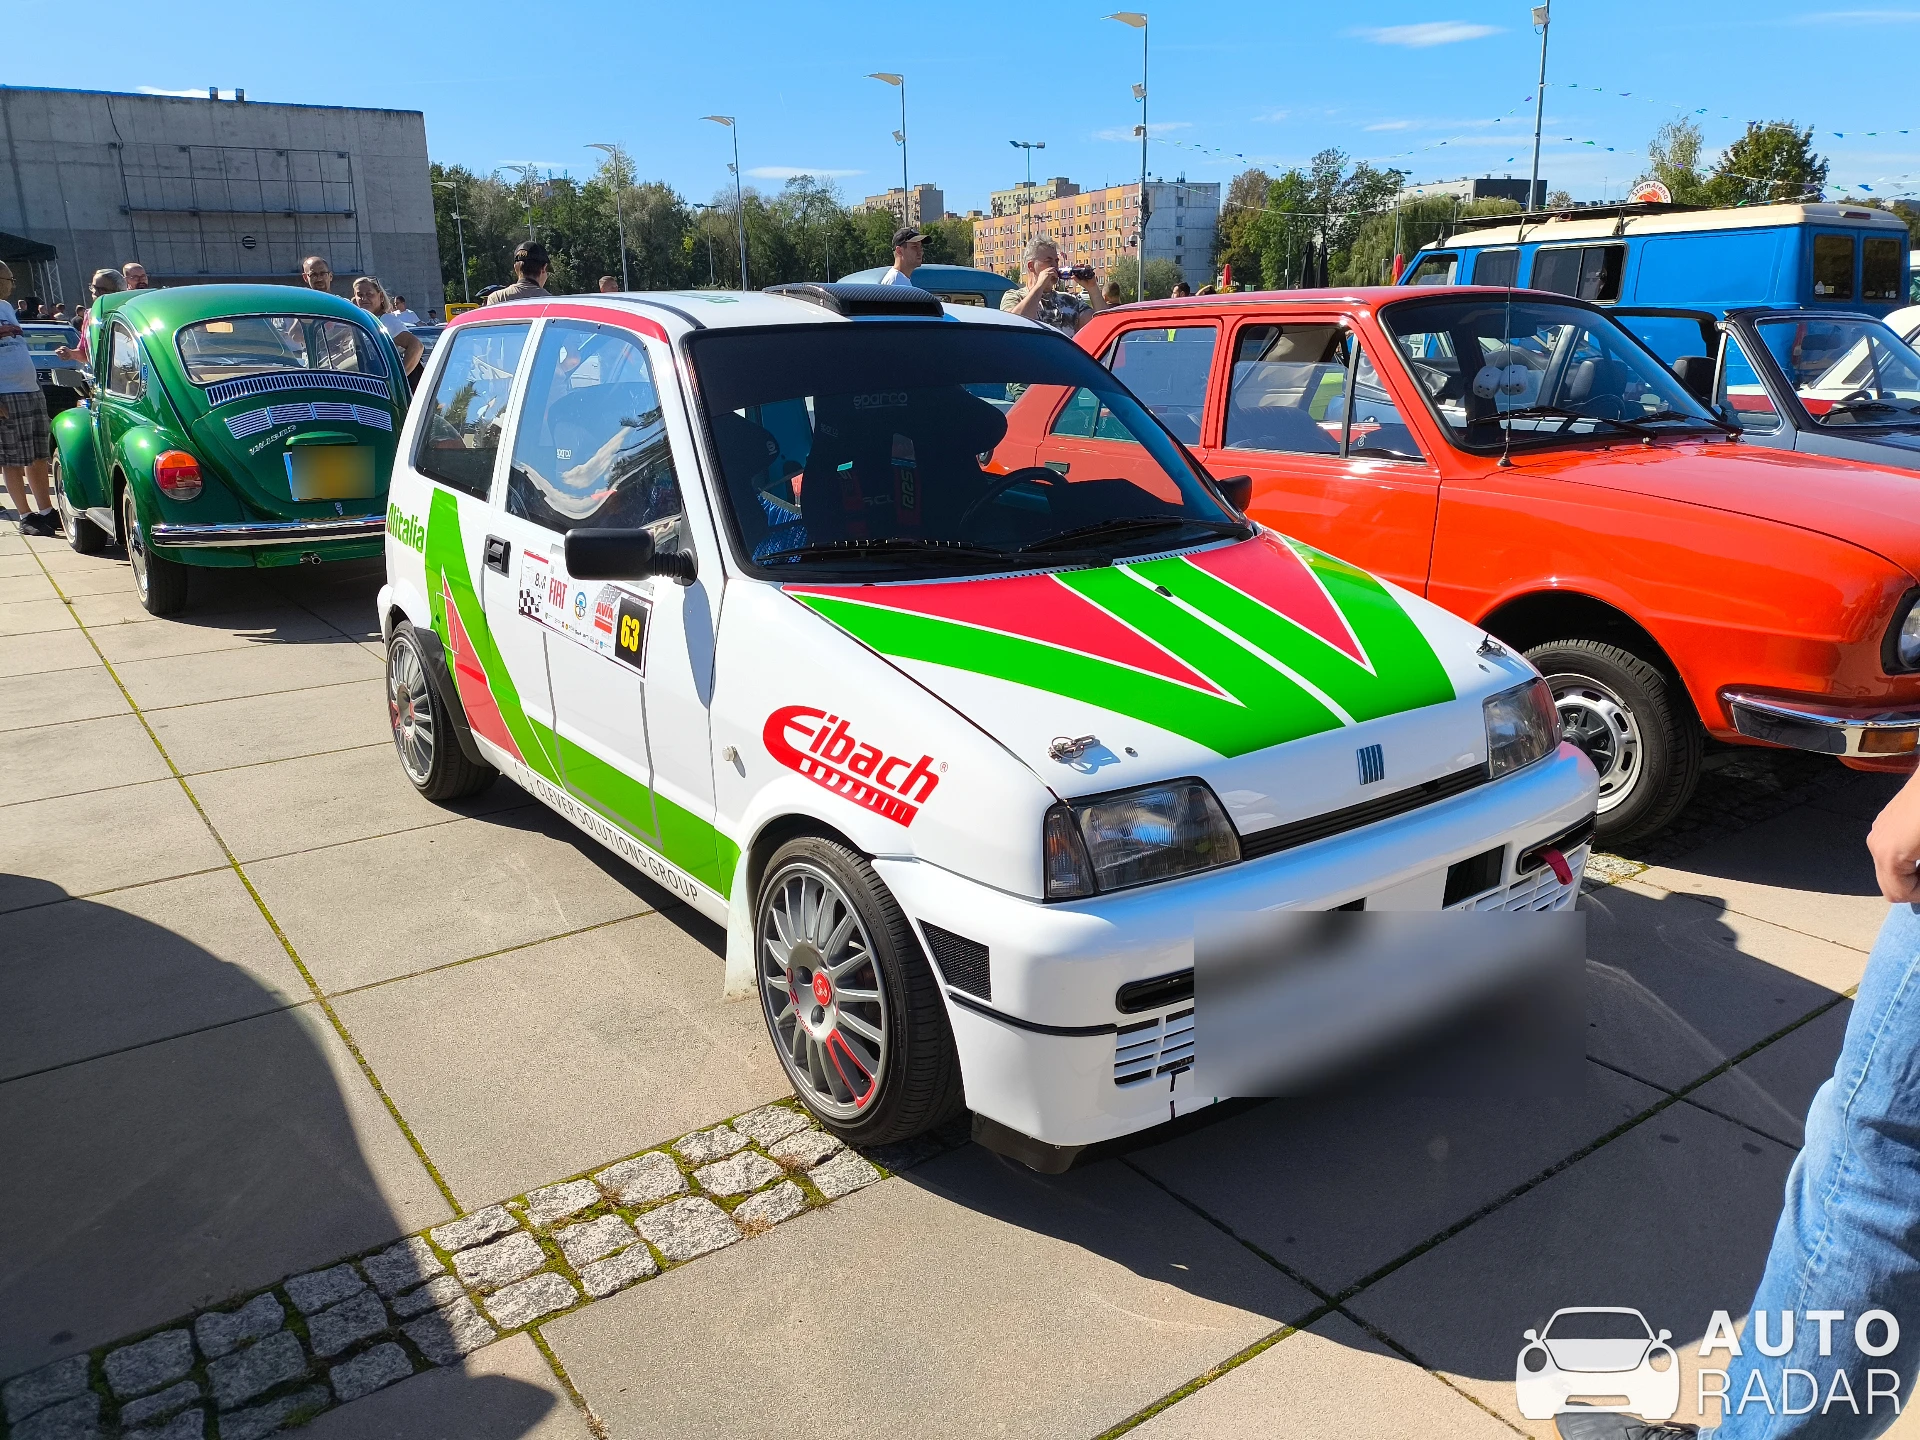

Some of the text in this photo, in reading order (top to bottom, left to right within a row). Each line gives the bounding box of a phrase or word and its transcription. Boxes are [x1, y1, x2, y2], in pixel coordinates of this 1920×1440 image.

[853, 391, 908, 409] sparco
[386, 502, 425, 554] Alitalia
[548, 577, 568, 610] FIAT
[595, 601, 615, 621] AVIA
[620, 614, 641, 652] 63
[763, 705, 940, 820] Eibach
[536, 779, 698, 902] CLEVER SOLUTIONS GROUP
[795, 1008, 814, 1037] RACING
